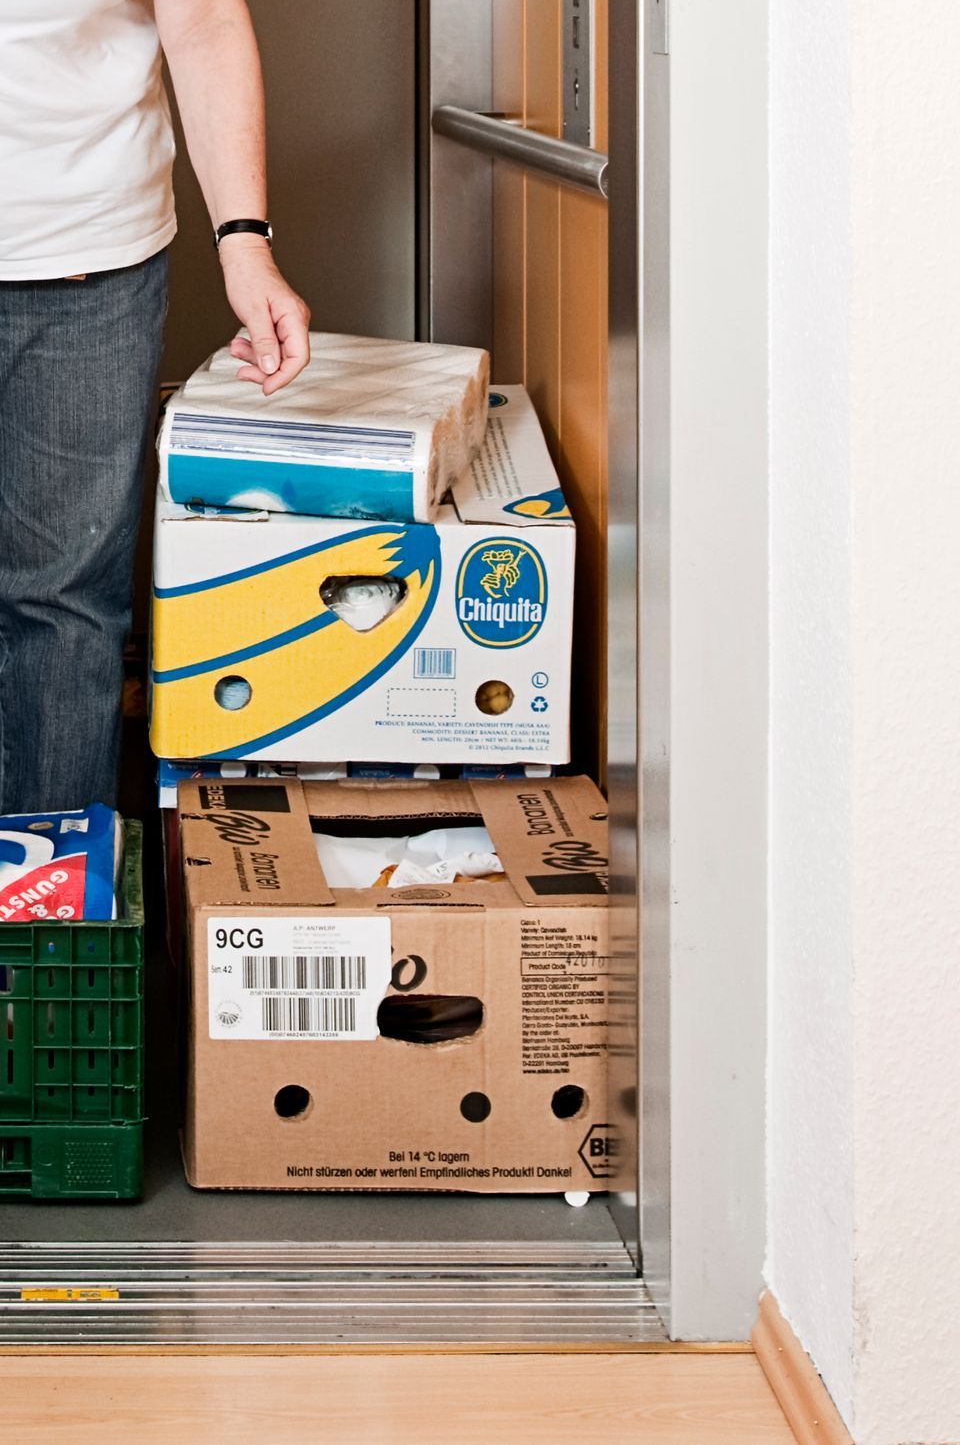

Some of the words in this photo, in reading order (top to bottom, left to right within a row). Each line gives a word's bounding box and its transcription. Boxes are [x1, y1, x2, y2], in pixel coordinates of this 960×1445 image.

[458, 597, 543, 628] Chiquita
[206, 785, 227, 810] EDEKA
[205, 811, 272, 846] Bio
[516, 793, 556, 836] Bananen
[542, 840, 608, 872] Bio
[250, 852, 281, 890] Bananen
[215, 928, 264, 949] 9CG
[223, 966, 232, 974] 42
[389, 1152, 406, 1162] Bei
[408, 1152, 420, 1162] 14
[438, 1152, 470, 1164] lagern
[286, 1166, 313, 1178] Nicht
[316, 1166, 352, 1178] stürzen
[355, 1166, 377, 1178] oder
[420, 1166, 490, 1180] Empfindliches
